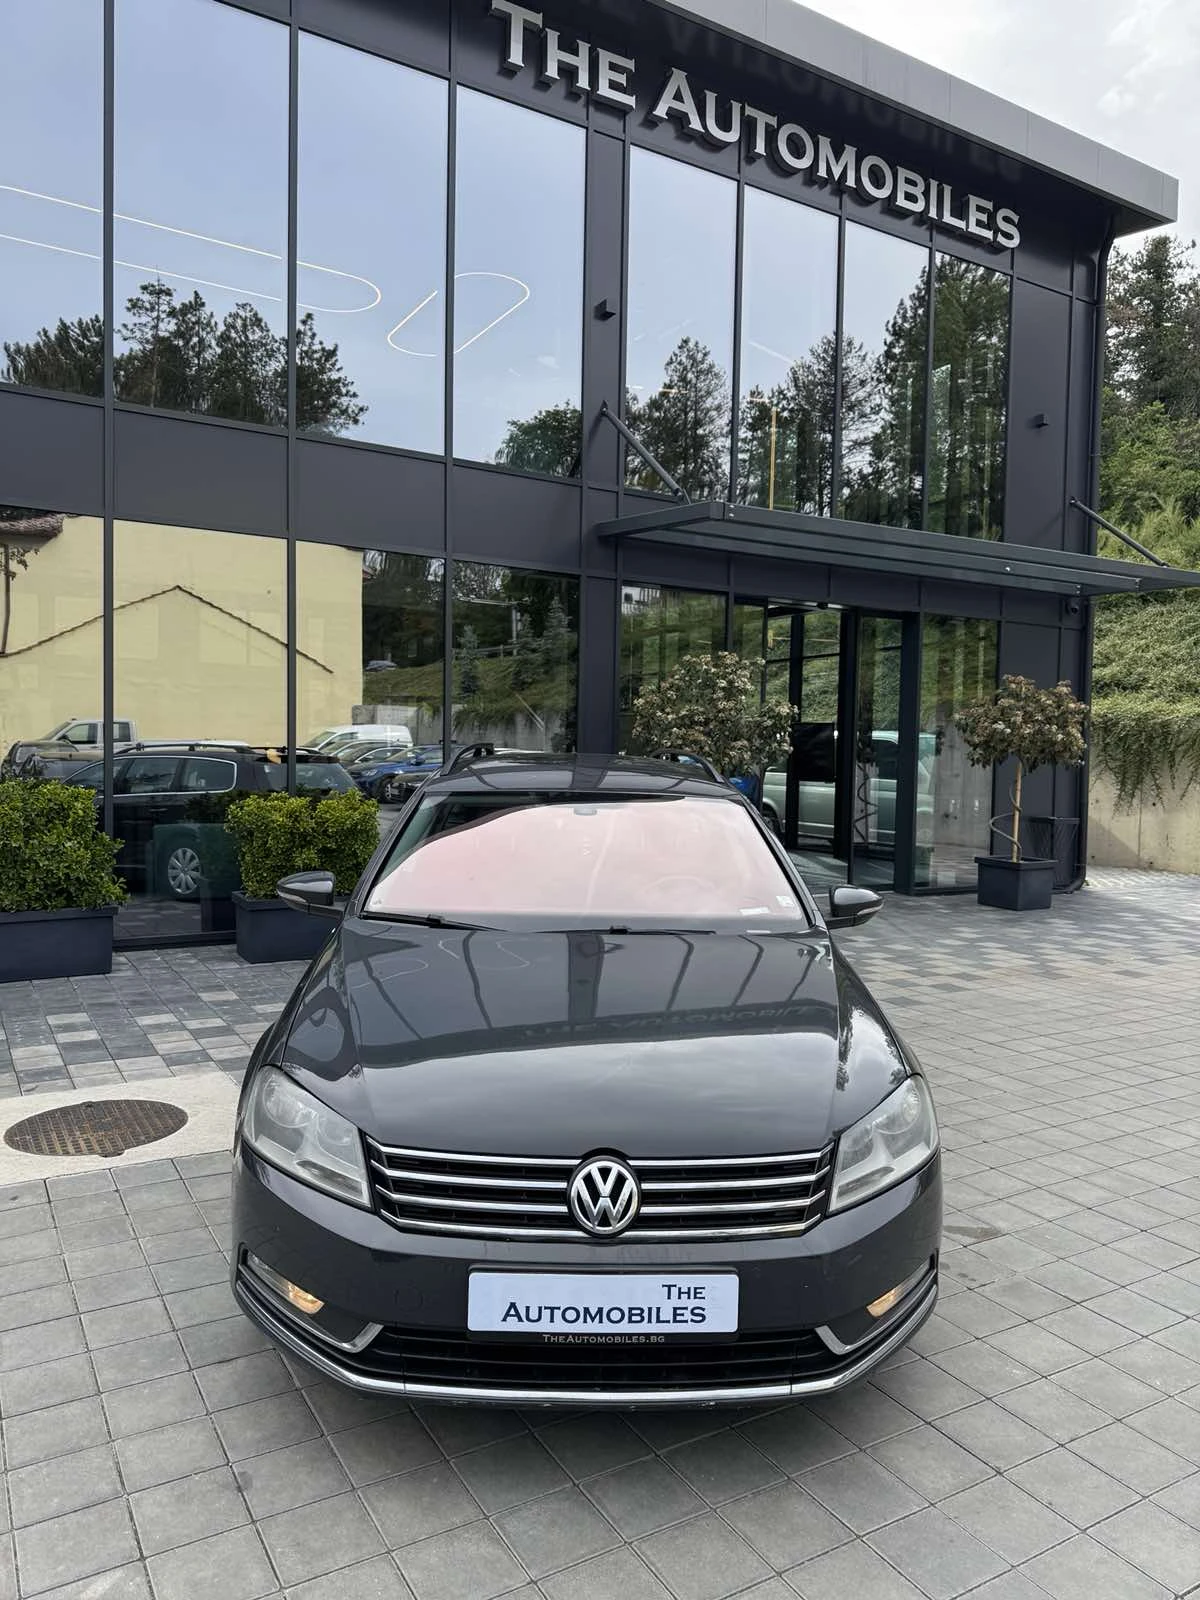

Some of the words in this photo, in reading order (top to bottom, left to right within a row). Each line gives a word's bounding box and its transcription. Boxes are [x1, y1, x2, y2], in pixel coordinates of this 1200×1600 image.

[491, 0, 636, 109] THE
[652, 67, 1021, 249] AUTOMOBILES
[573, 1163, 636, 1231] VW
[501, 1302, 706, 1324] AUTOMOBILES
[662, 1284, 706, 1300] THE
